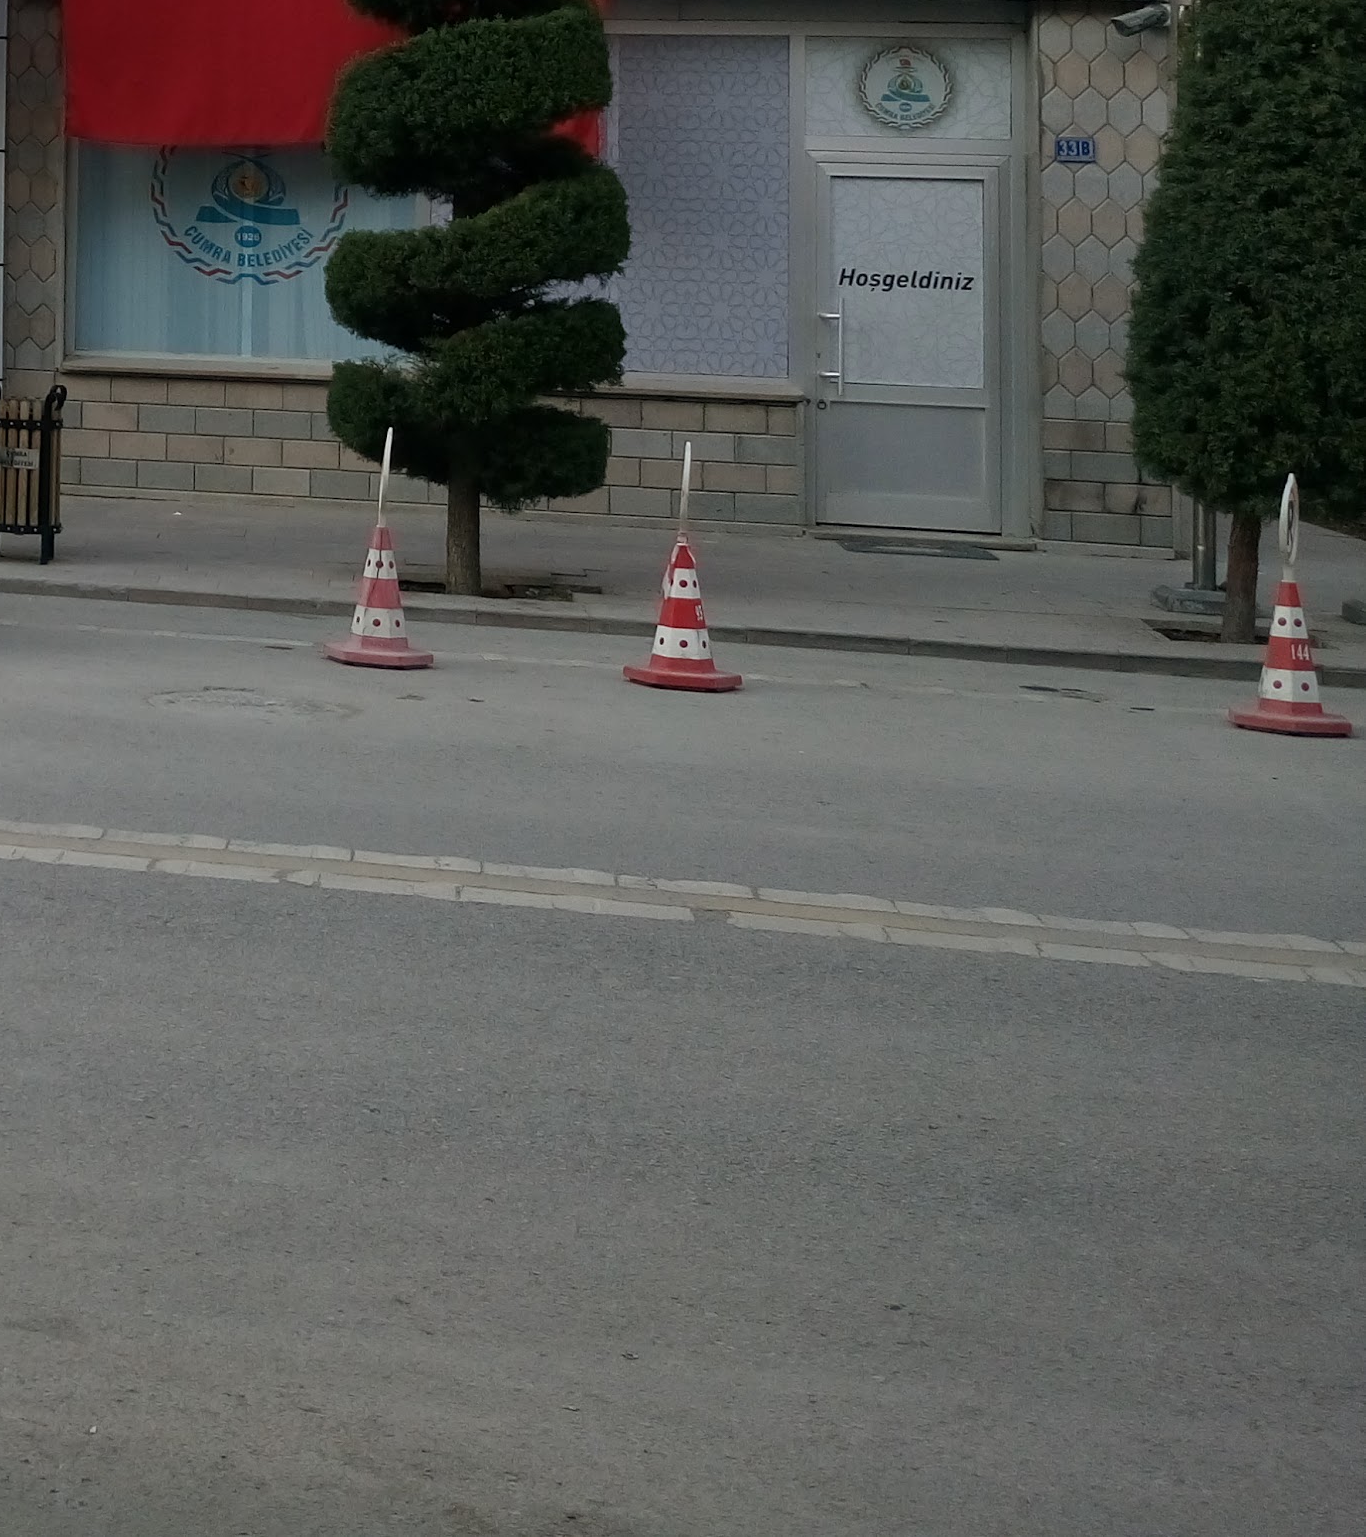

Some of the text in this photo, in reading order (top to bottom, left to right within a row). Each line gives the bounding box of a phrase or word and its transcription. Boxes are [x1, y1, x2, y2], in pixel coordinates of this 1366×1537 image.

[236, 227, 315, 268] BELEDİYESİ
[838, 267, 975, 292] Hoşgeldiniz
[1290, 643, 1310, 662] 144
